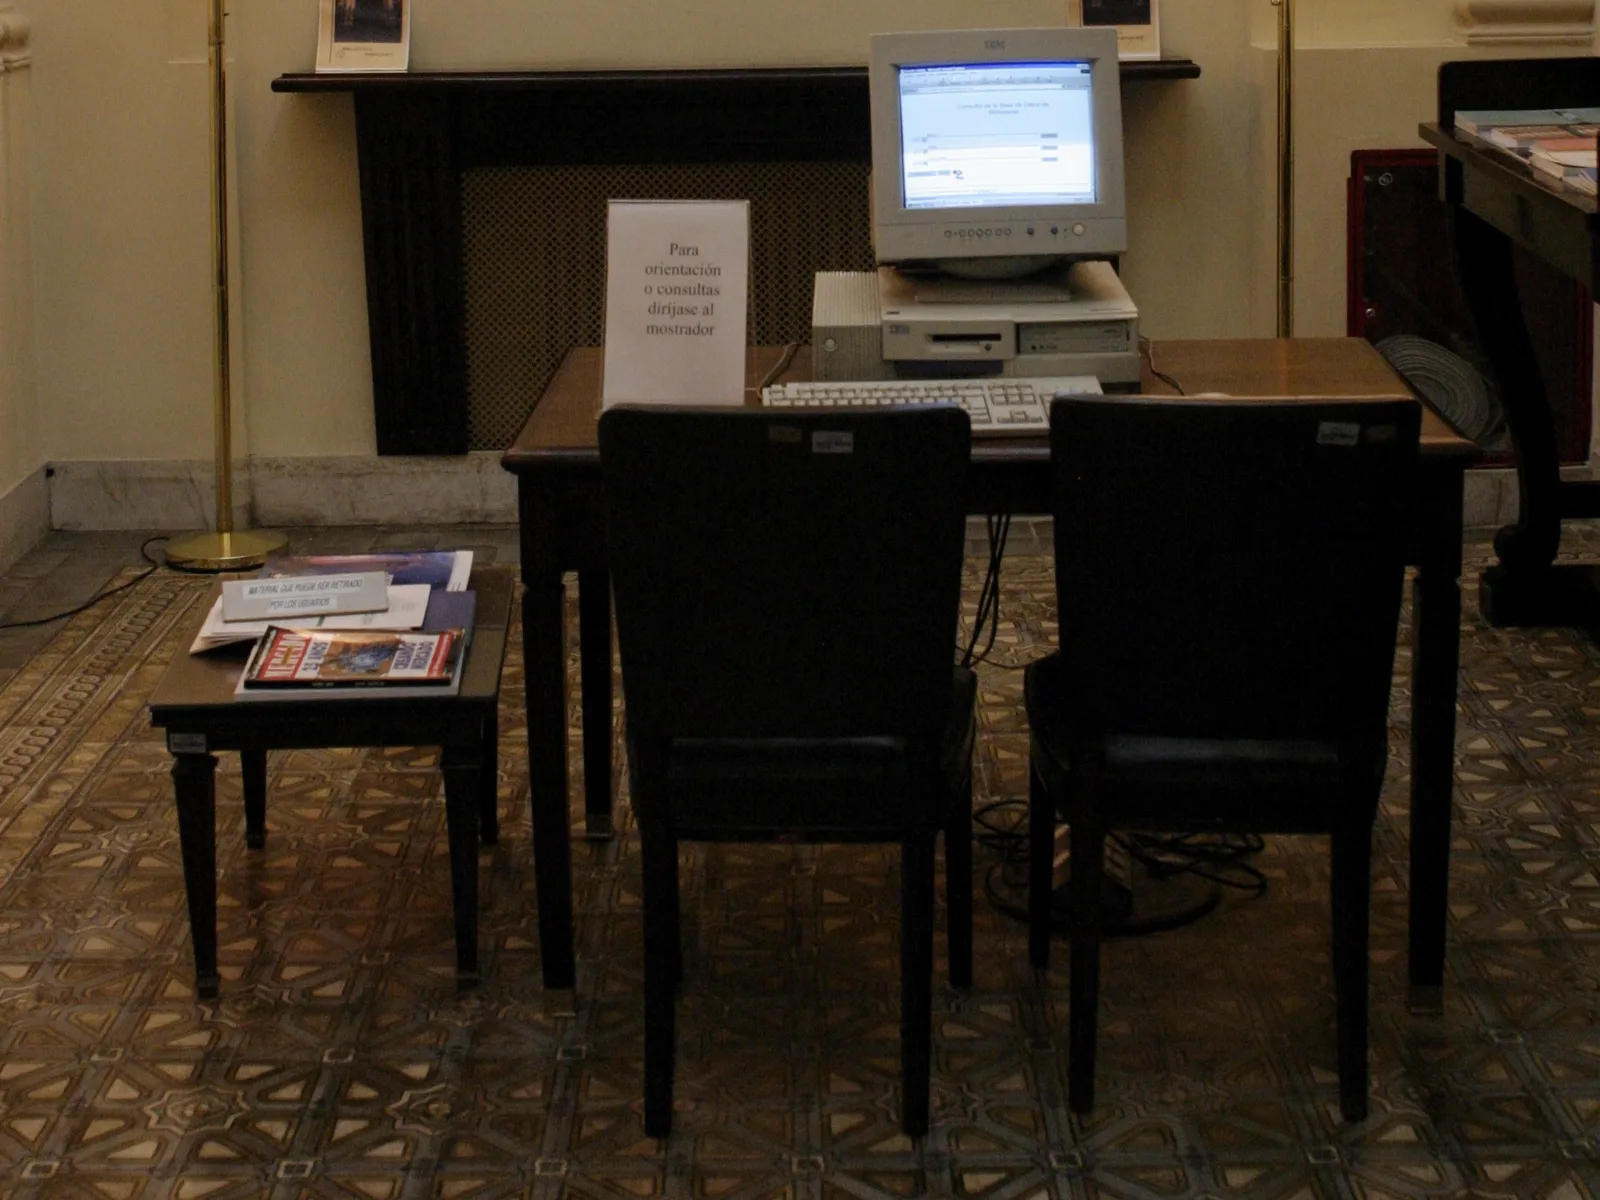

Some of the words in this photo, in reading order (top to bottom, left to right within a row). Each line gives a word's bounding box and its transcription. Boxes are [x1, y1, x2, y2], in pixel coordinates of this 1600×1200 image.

[669, 243, 699, 256] Para
[644, 261, 722, 276] orientación
[644, 284, 653, 295] o
[657, 282, 721, 296] consultas
[702, 302, 715, 316] al
[646, 321, 716, 336] mostrador
[248, 584, 280, 595] MATERIAL
[280, 583, 294, 594] QUE
[295, 582, 316, 593] PUEDE
[316, 580, 330, 591] SER
[330, 578, 363, 589] RETIRADO
[269, 600, 283, 610] POR
[284, 599, 297, 609] LOS
[297, 597, 331, 609] USUARIOS
